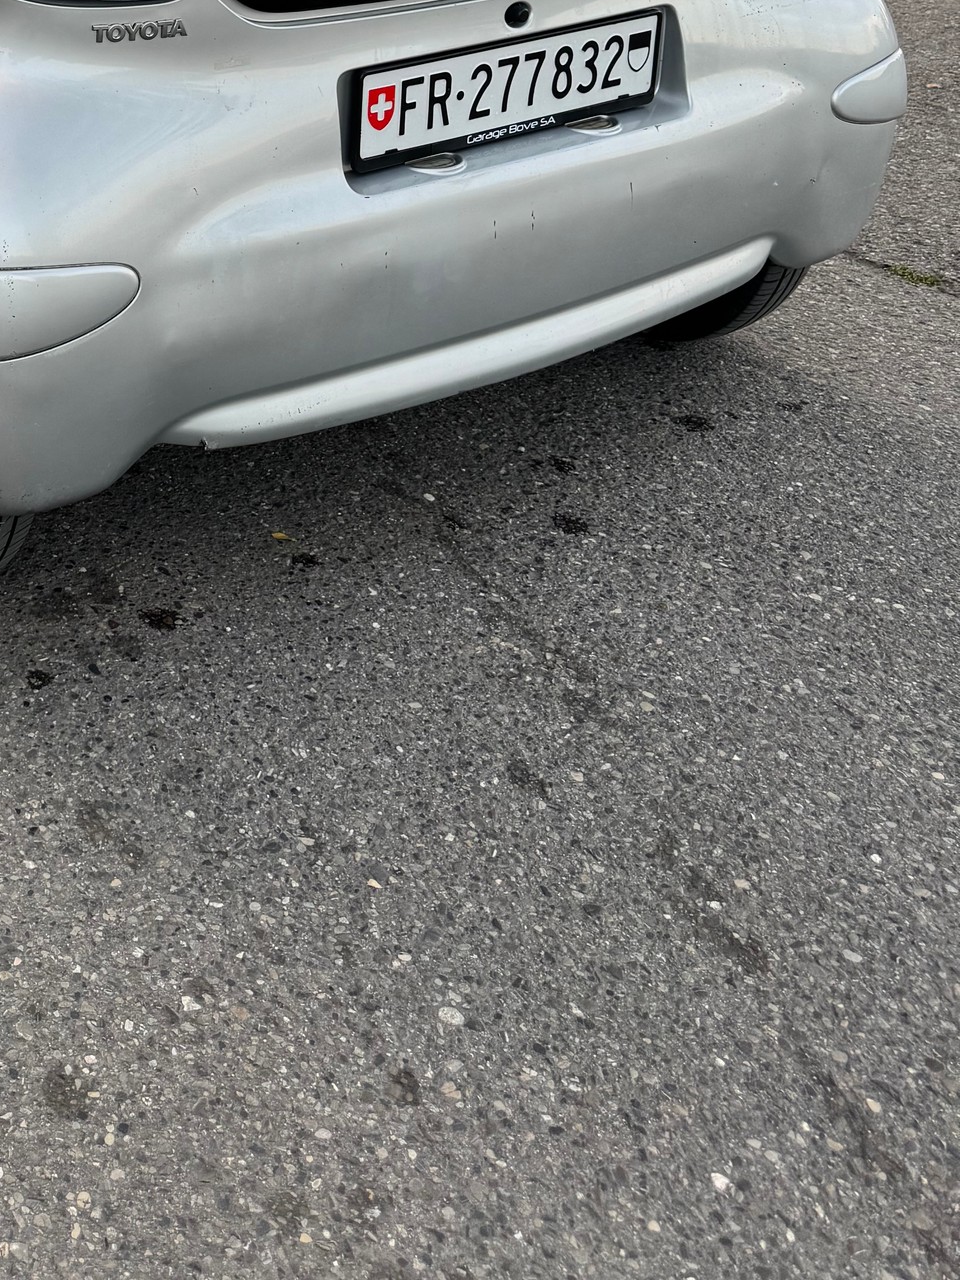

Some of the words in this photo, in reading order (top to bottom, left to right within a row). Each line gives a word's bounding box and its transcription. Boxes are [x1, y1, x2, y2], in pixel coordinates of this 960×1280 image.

[91, 18, 188, 43] TOYOTA
[466, 127, 508, 144] Garage
[508, 121, 539, 134] Bove
[540, 115, 556, 127] SA
